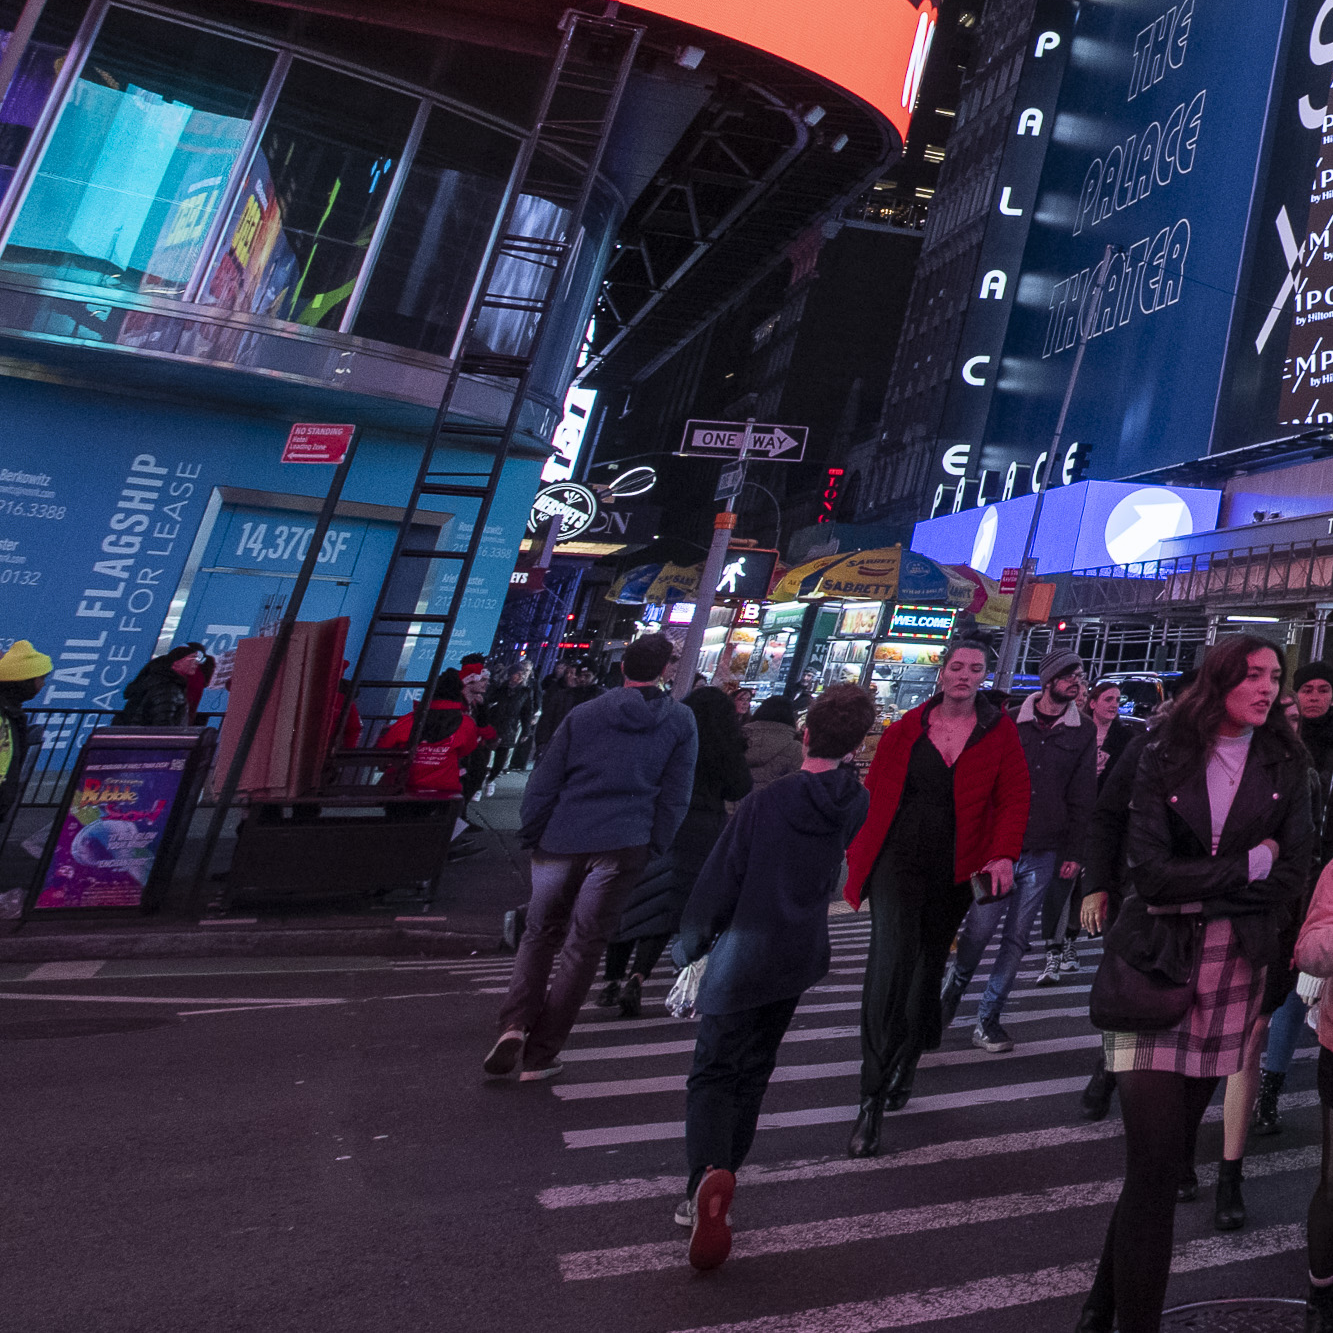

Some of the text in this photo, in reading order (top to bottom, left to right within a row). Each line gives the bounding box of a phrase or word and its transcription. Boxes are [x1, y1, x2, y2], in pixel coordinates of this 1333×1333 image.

[1073, 89, 1206, 237] PALACE
[942, 31, 1061, 476] PALACE
[1042, 218, 1191, 359] THEATER
[295, 427, 306, 435] NO
[702, 432, 788, 449] ONE WAY
[930, 442, 1079, 519] PALACE
[76, 453, 168, 617] FLAGSHIP
[120, 462, 202, 631] FOR LEASE
[318, 529, 351, 564] SF
[824, 580, 894, 595] SABRETT
